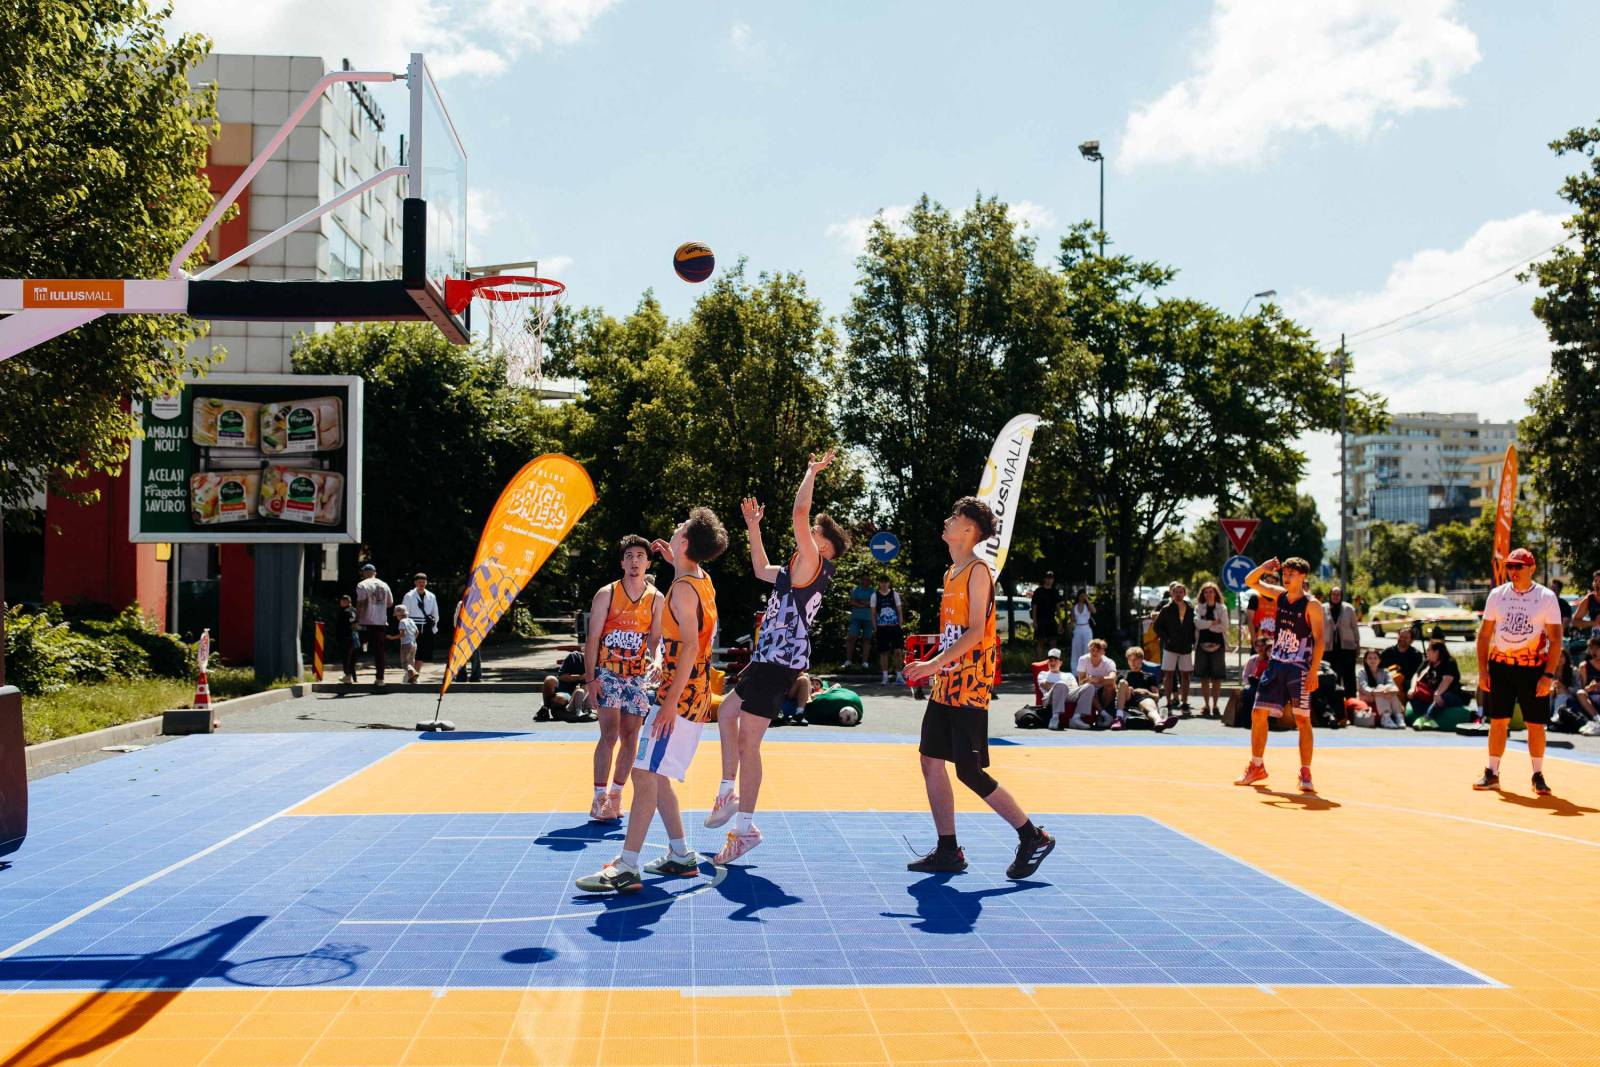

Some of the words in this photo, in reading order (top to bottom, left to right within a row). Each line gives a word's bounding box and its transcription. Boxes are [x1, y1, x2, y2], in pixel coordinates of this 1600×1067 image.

[49, 291, 113, 302] IULIUSMALL
[147, 426, 189, 439] AMBALAJ
[144, 484, 187, 500] Fragedo
[145, 500, 186, 512] SAVUROS
